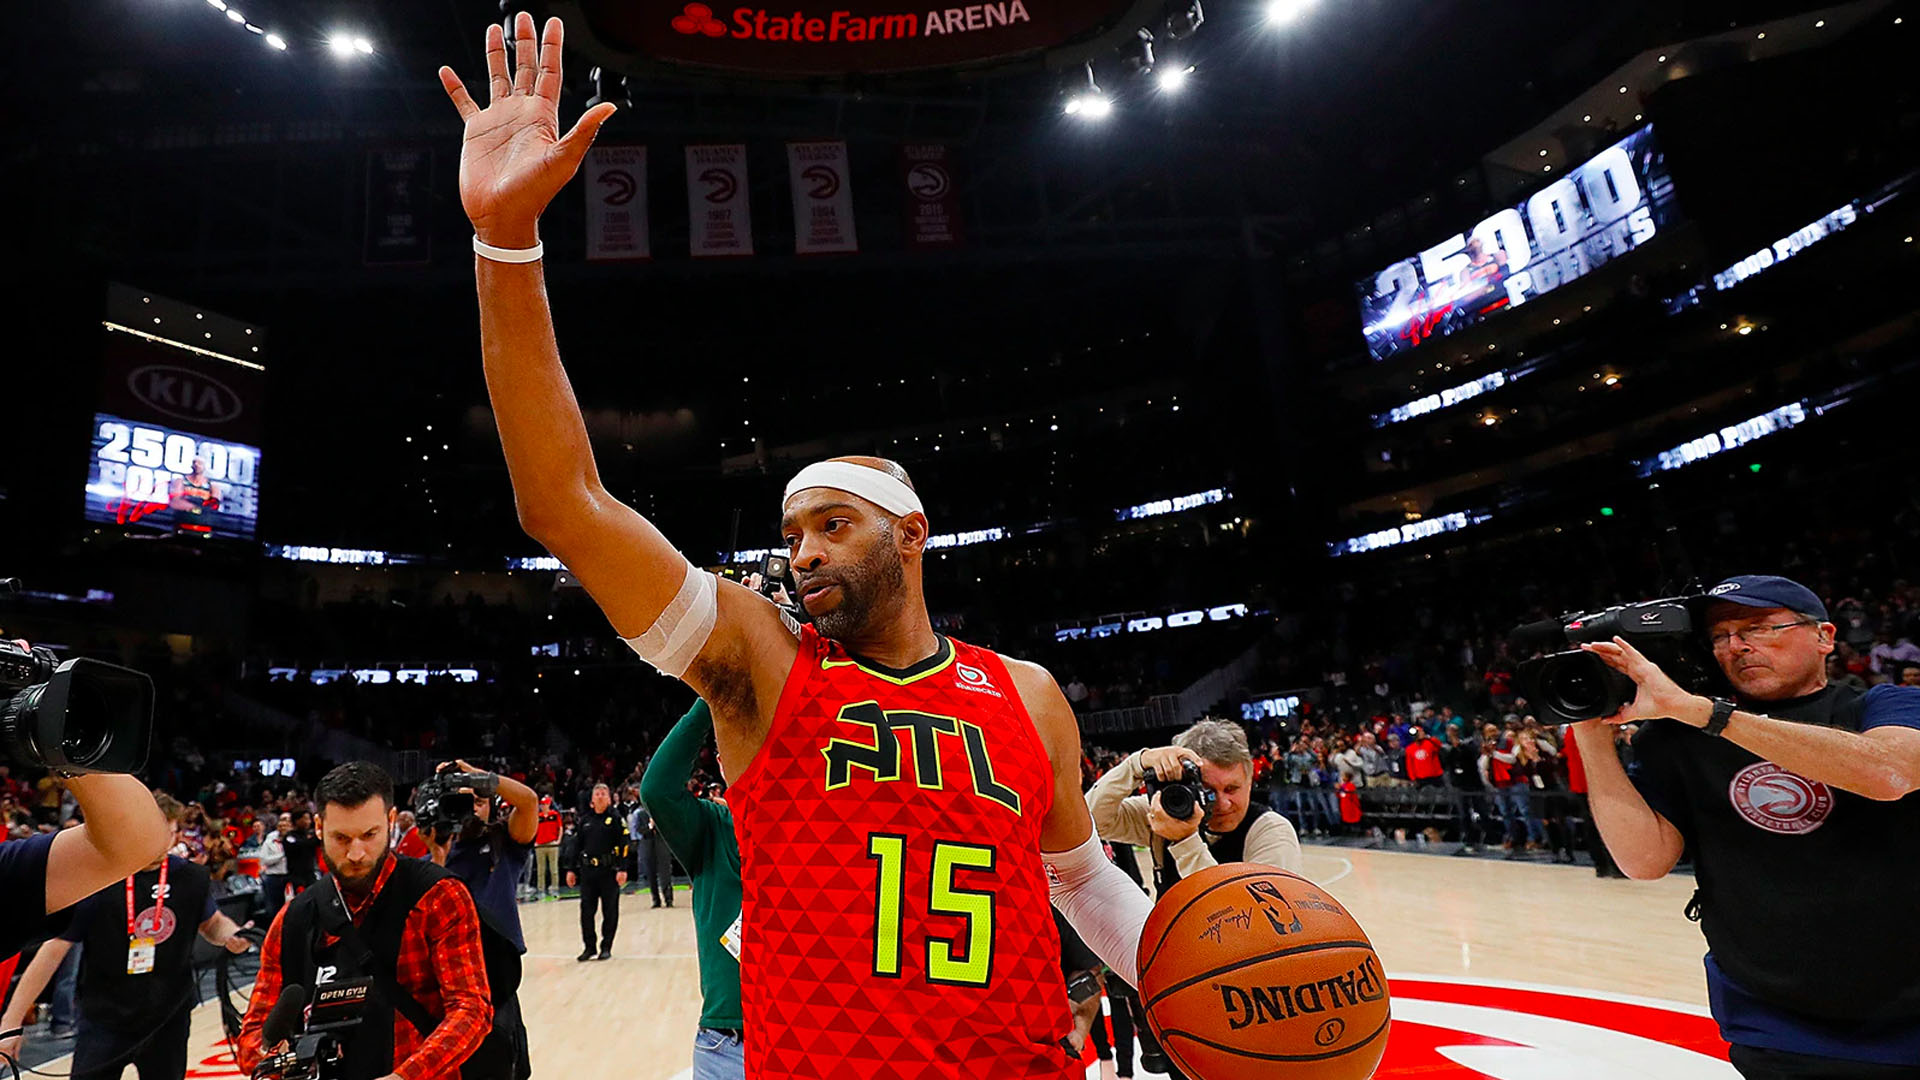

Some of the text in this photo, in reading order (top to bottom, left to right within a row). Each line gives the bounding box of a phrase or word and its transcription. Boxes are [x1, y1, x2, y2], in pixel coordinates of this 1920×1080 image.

[924, 0, 1030, 36] ARENA
[1376, 146, 1641, 316] 25000
[1503, 206, 1657, 308] POINTS
[1772, 203, 1857, 261] POINTS
[150, 372, 223, 415] KIA
[97, 422, 257, 486] 25000
[1719, 402, 1806, 450] POINTS
[820, 699, 1022, 817] ATL
[866, 831, 997, 989] 15
[320, 986, 368, 1000] OPEN GYM
[1219, 955, 1385, 1031] SPALDING
